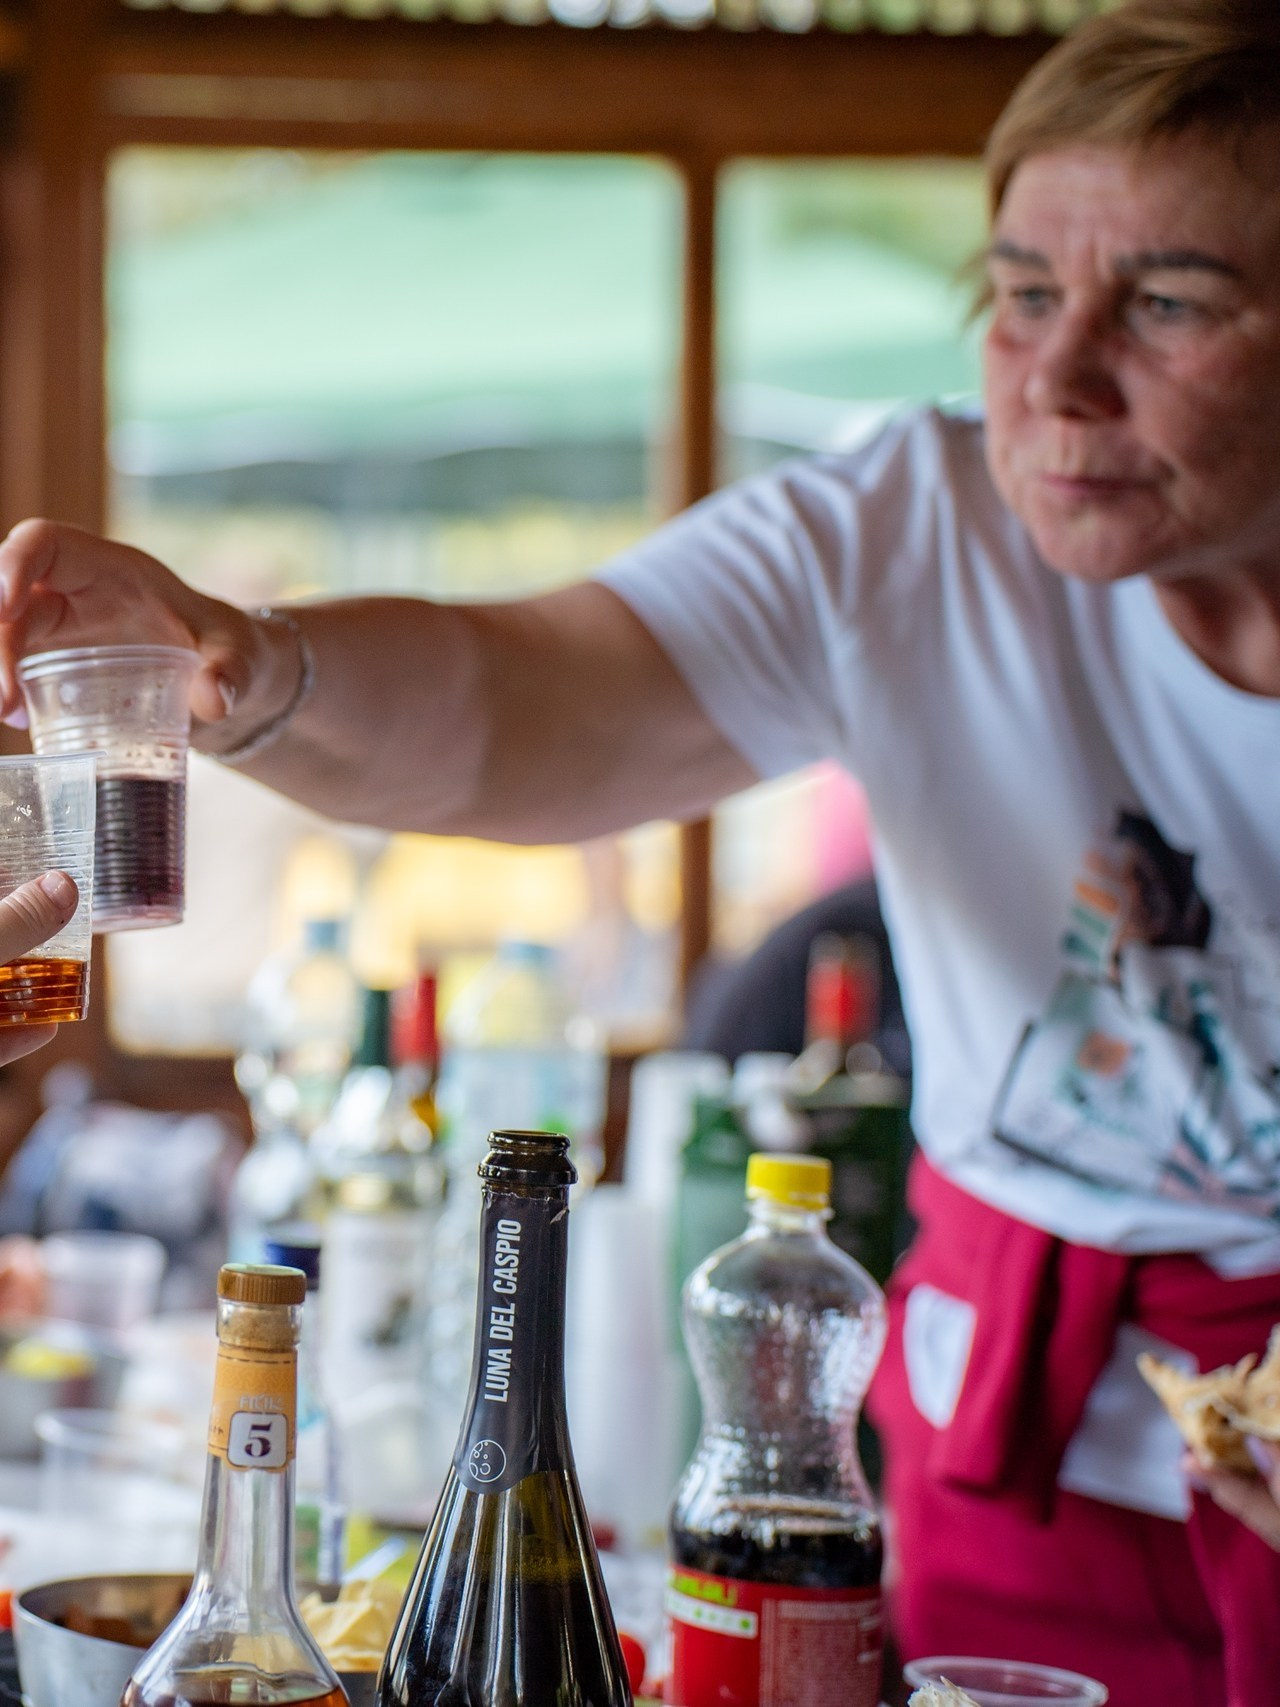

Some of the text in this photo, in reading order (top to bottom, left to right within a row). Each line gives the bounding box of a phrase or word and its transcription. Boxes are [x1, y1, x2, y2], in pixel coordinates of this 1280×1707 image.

[484, 1219, 522, 1403] LUNA DEL CASPIO
[244, 1422, 272, 1457] 5
